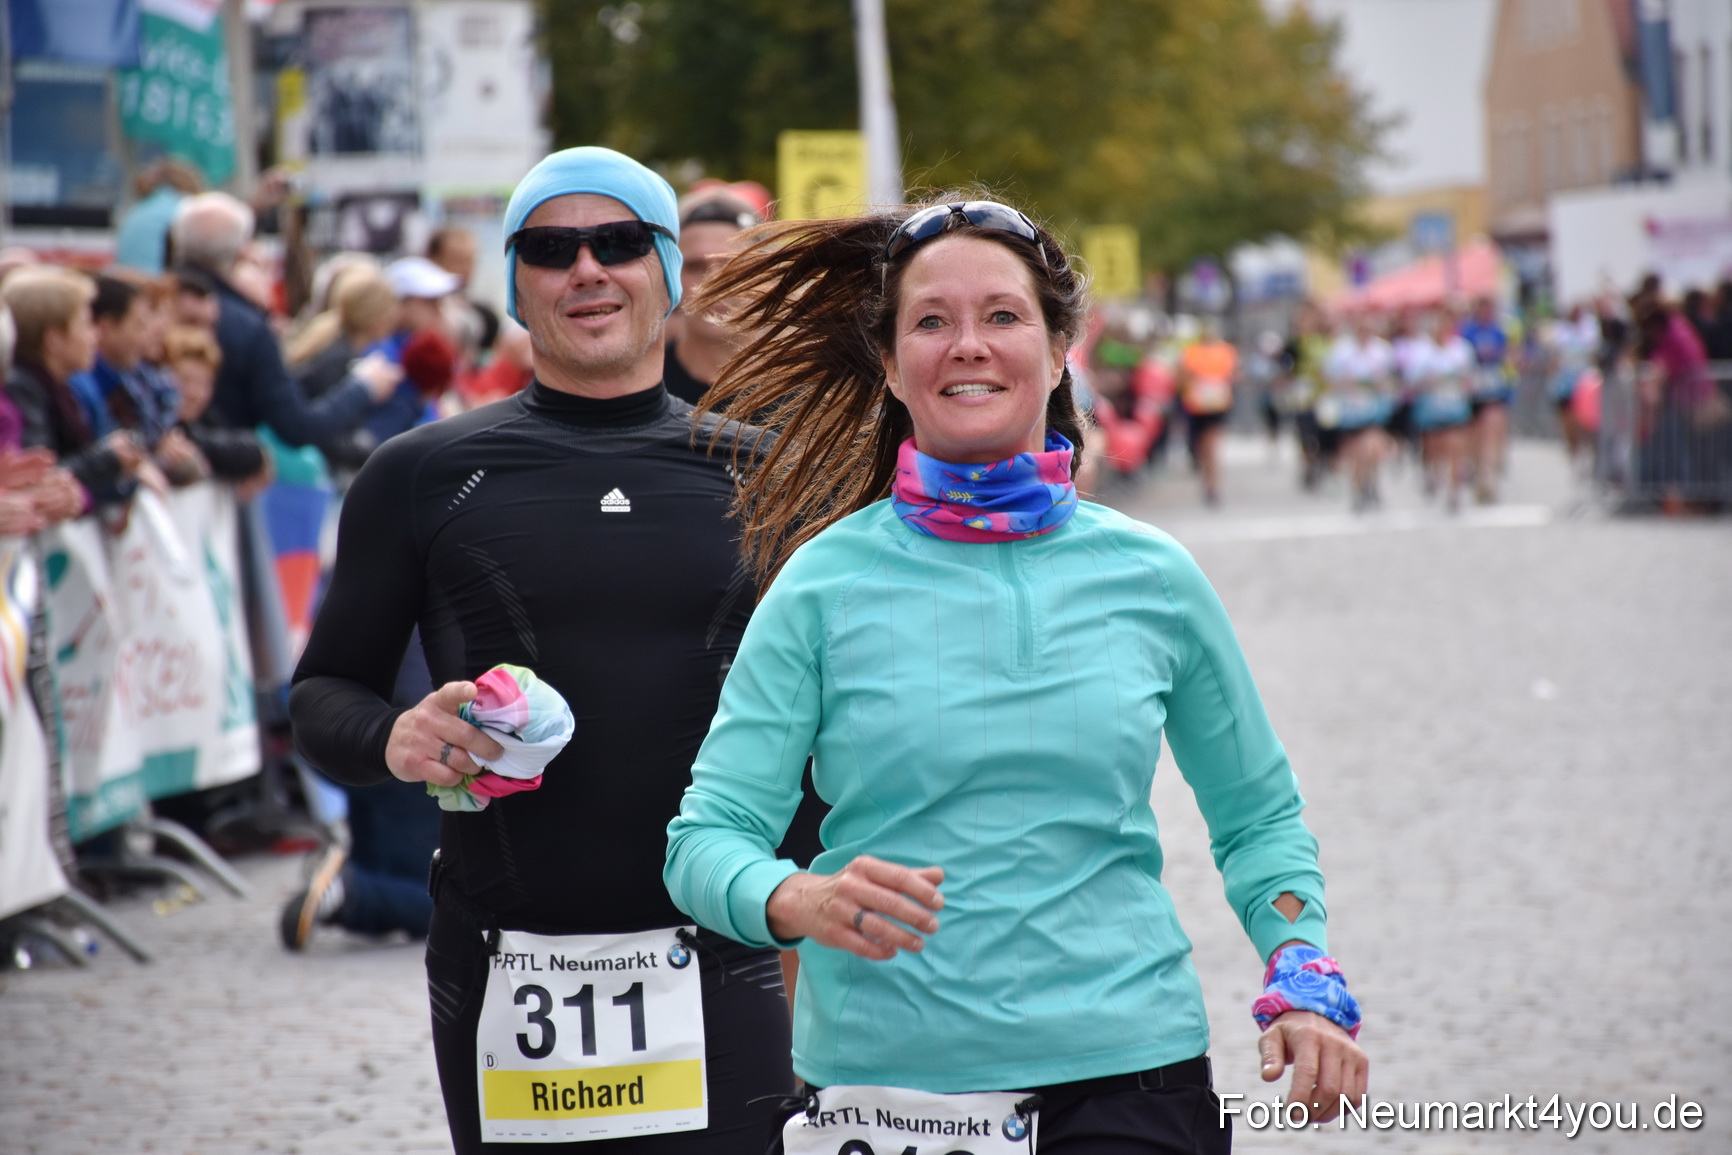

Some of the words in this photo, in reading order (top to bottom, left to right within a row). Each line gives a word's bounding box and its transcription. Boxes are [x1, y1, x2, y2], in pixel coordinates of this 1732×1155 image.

[549, 951, 658, 971] Neumarkt
[513, 981, 647, 1060] 311
[486, 1054, 494, 1068] D
[531, 1075, 644, 1112] Richard
[876, 1108, 991, 1137] Neumarkt
